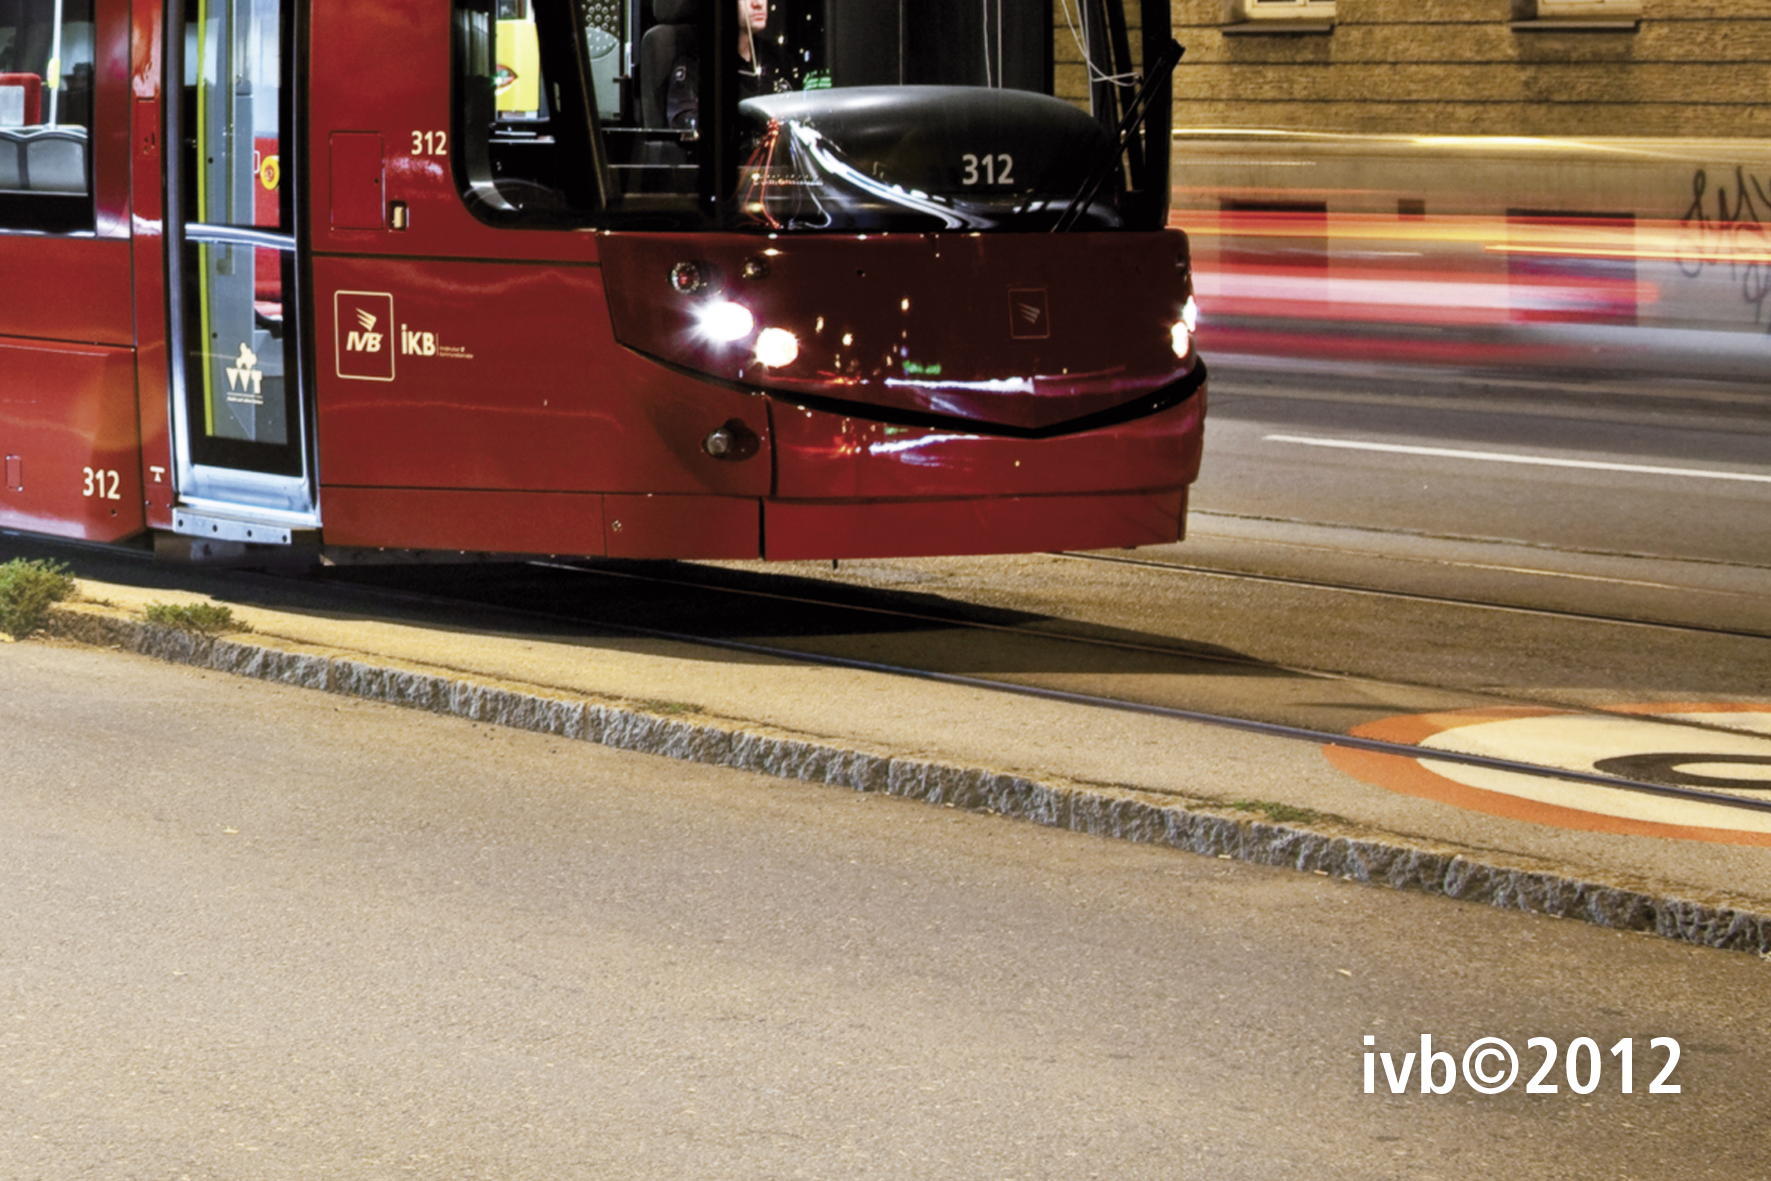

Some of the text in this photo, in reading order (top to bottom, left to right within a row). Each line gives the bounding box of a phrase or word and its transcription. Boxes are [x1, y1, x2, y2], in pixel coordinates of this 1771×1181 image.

[411, 130, 447, 155] 312
[962, 153, 1014, 185] 312
[346, 331, 383, 353] IVB
[82, 466, 121, 500] 312
